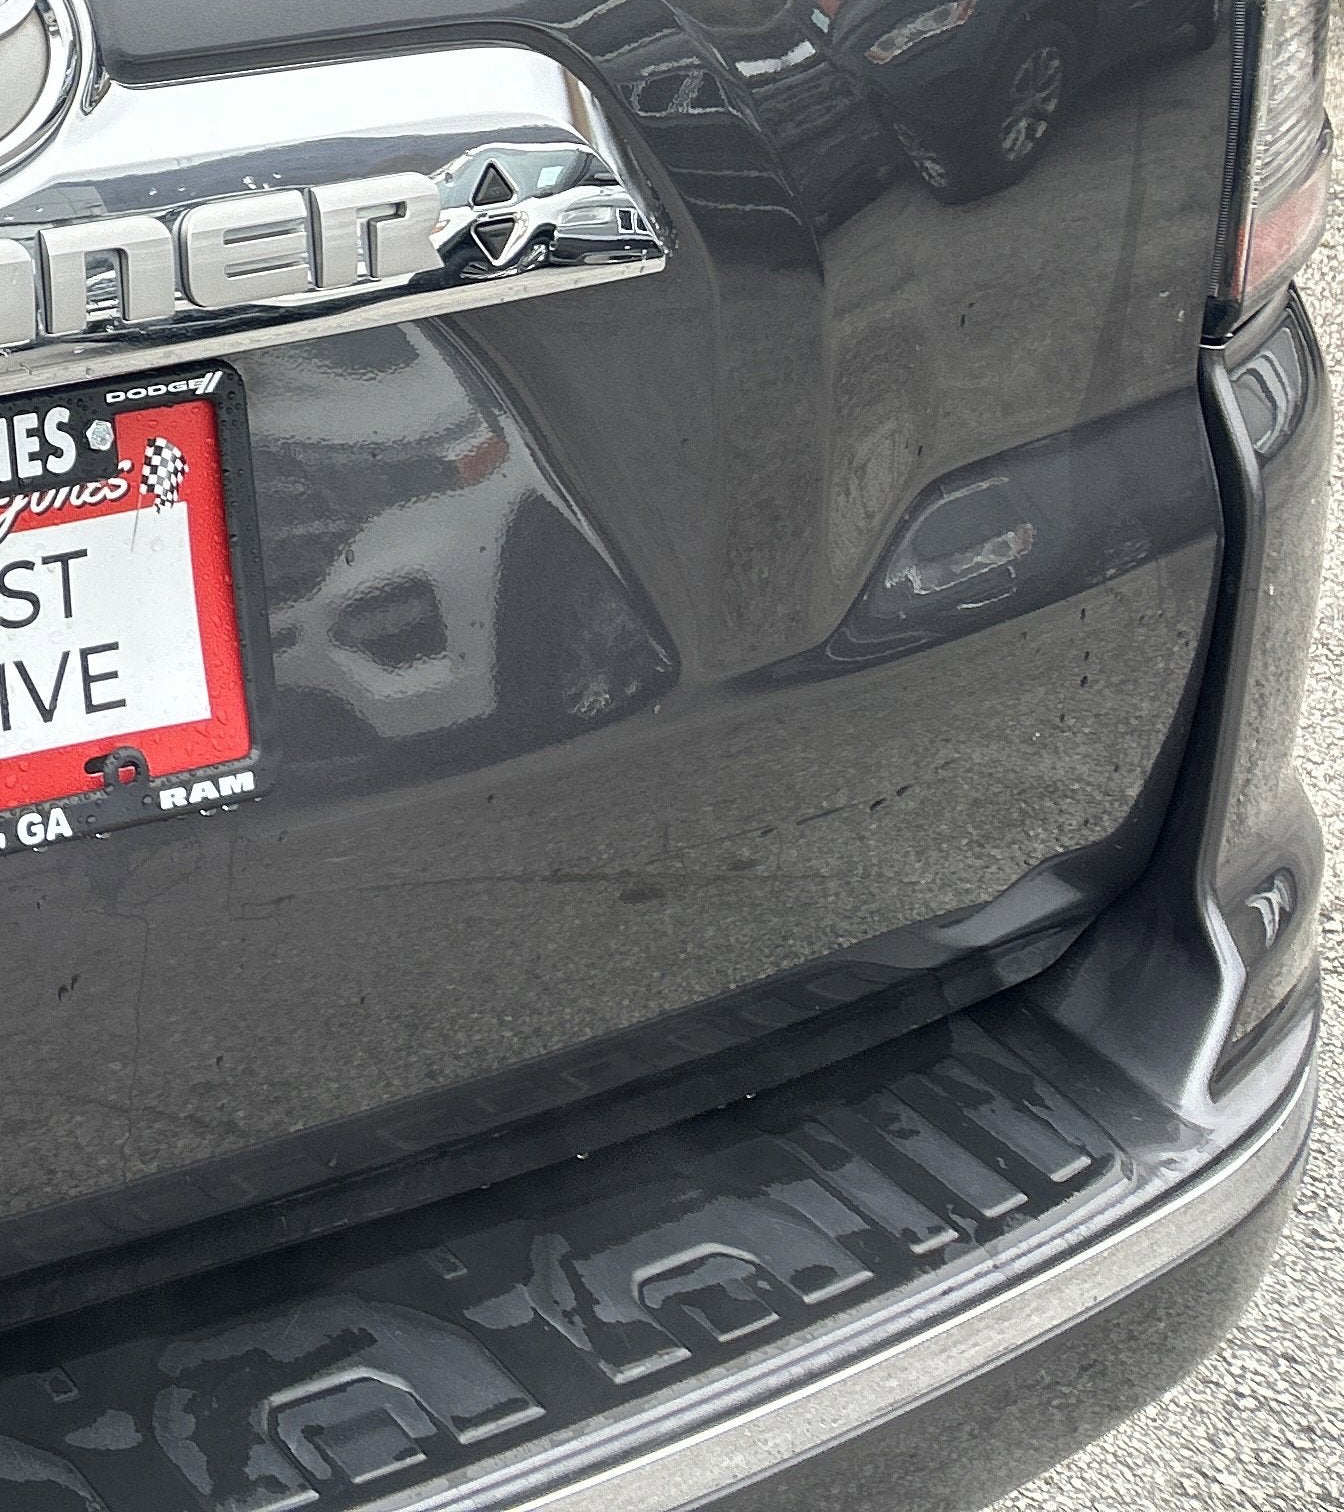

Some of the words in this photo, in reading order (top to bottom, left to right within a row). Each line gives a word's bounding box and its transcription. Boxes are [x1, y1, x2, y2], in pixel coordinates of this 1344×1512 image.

[105, 372, 208, 404] DODGE
[159, 771, 256, 810] RAM
[16, 807, 73, 846] GA
